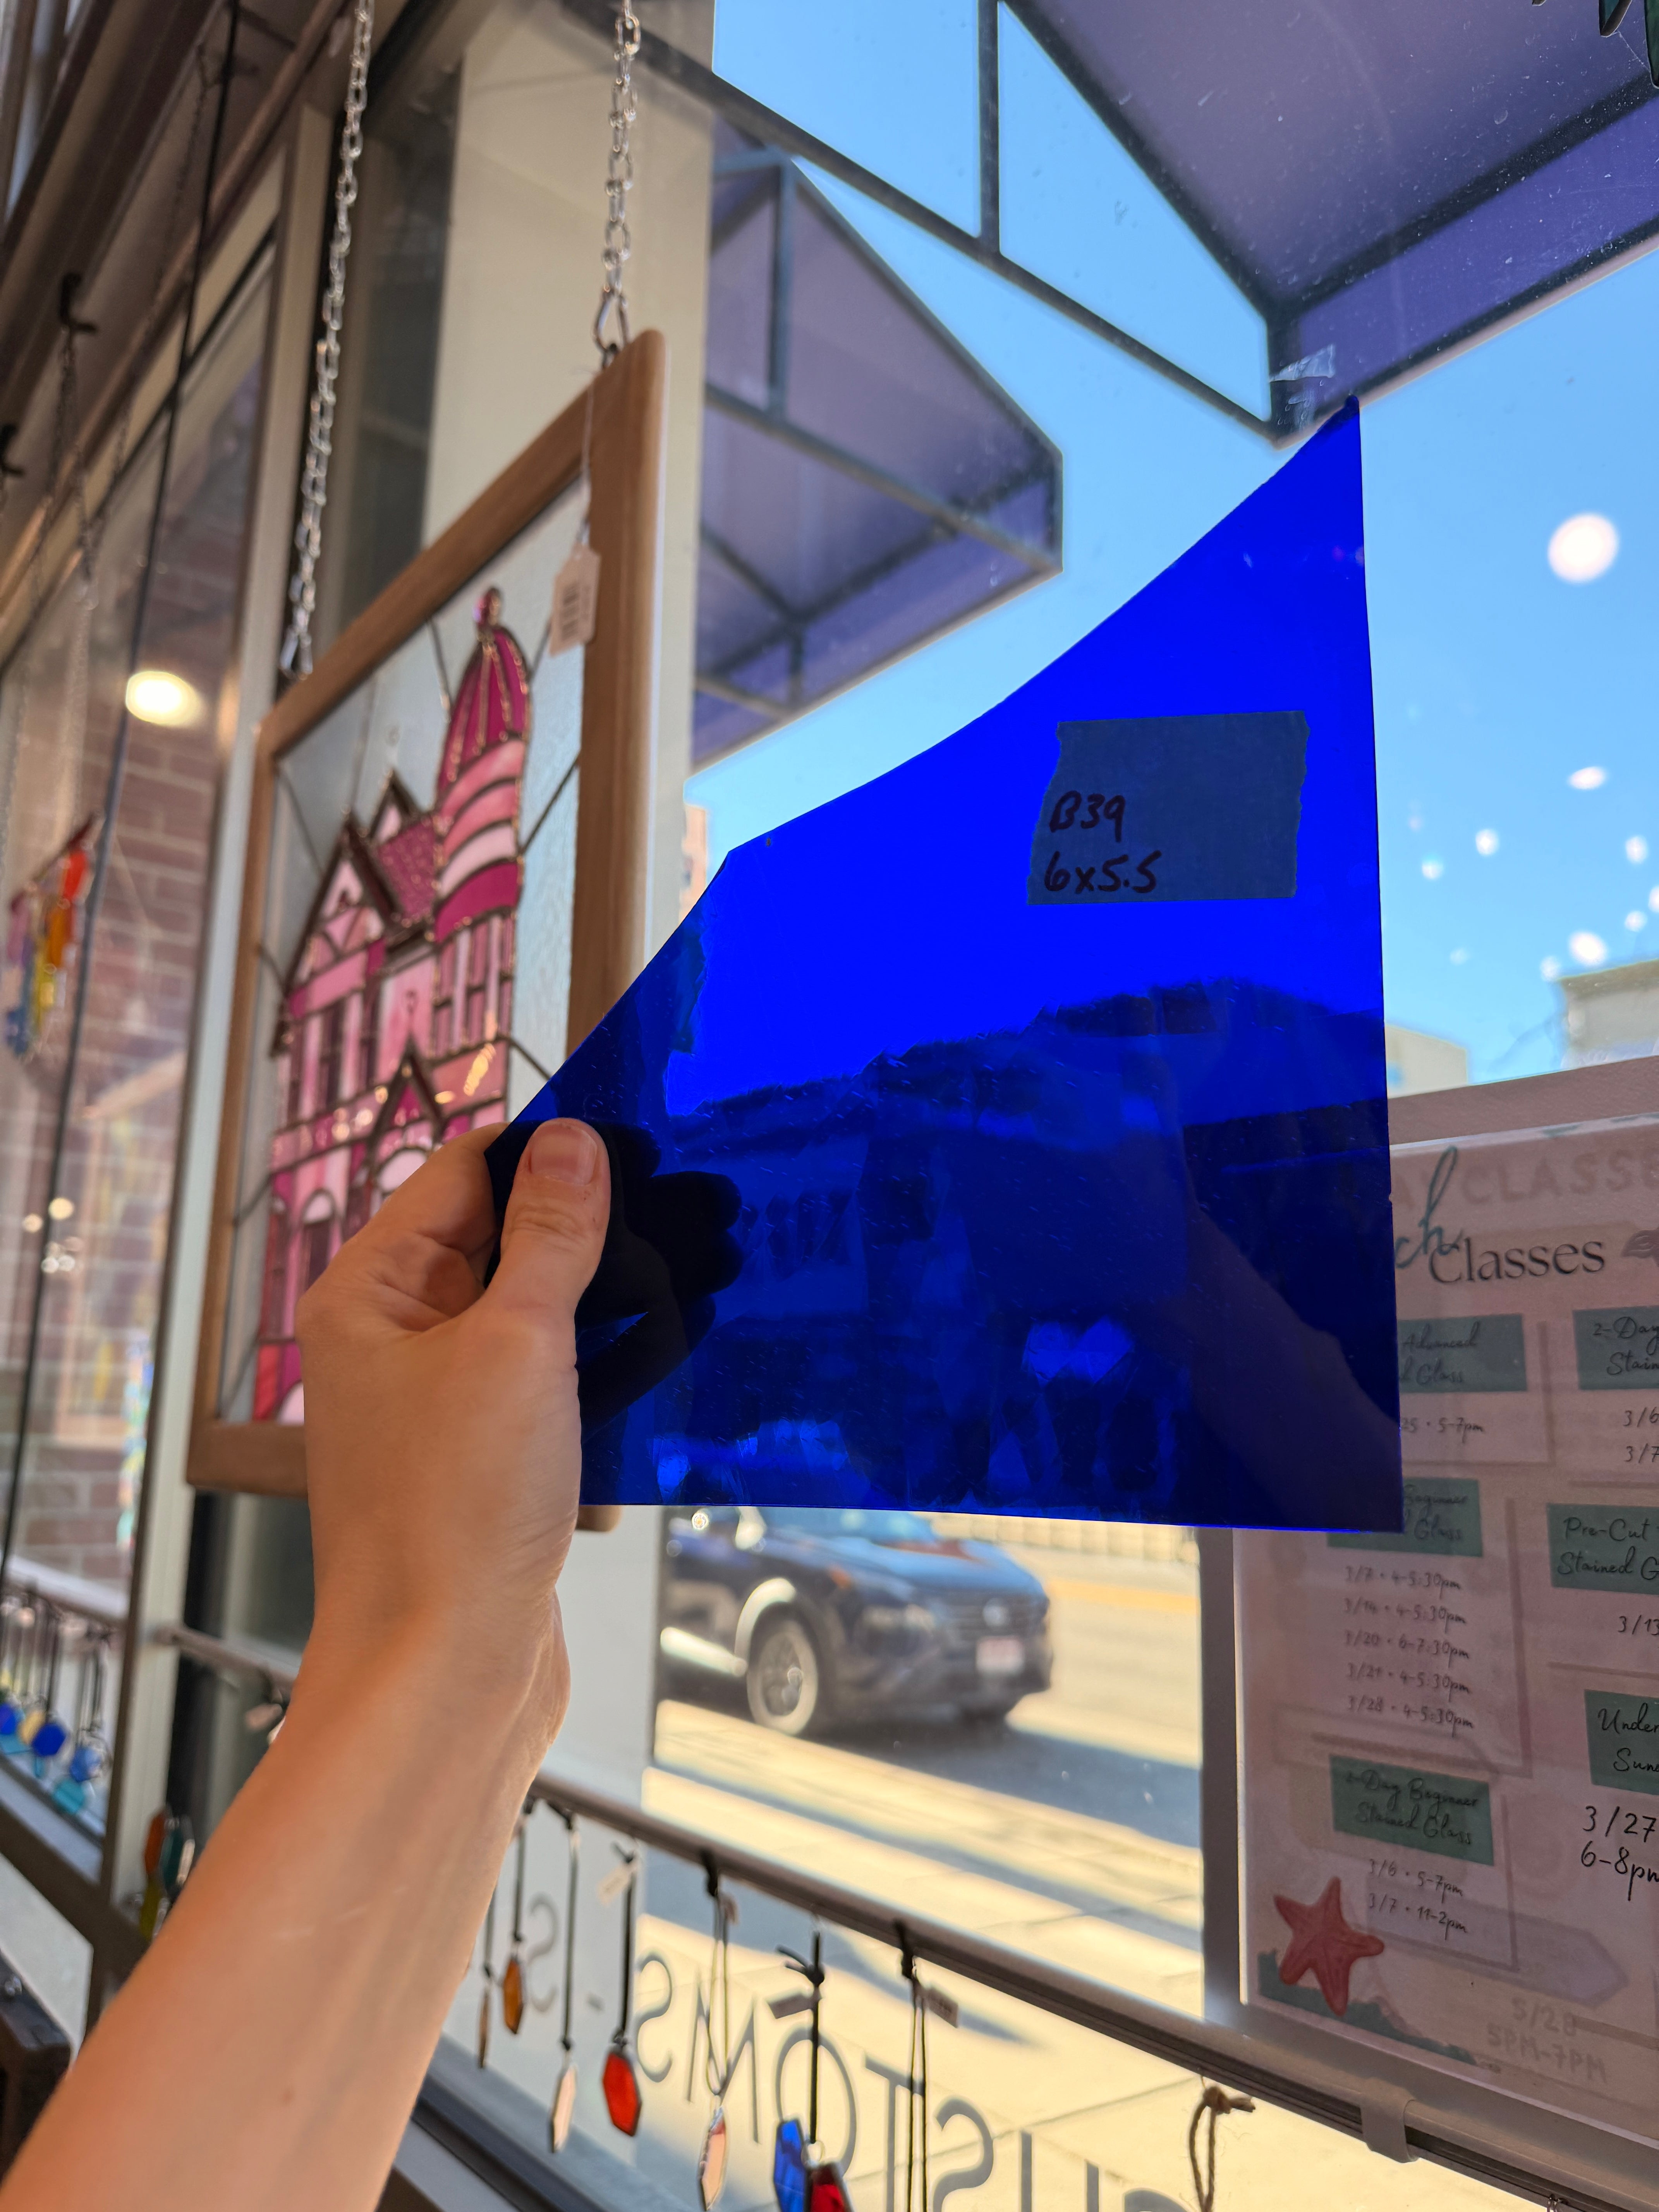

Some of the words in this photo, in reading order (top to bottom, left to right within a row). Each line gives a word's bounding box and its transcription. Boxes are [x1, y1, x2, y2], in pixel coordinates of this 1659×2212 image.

[1049, 790, 1126, 843] B39
[1044, 850, 1162, 894] 6x5.5
[1429, 1238, 1604, 1283] Classes
[1563, 1516, 1650, 1542] Pre-Cut
[1557, 1546, 1635, 1575] Stained
[1583, 1806, 1657, 1843] 3/27
